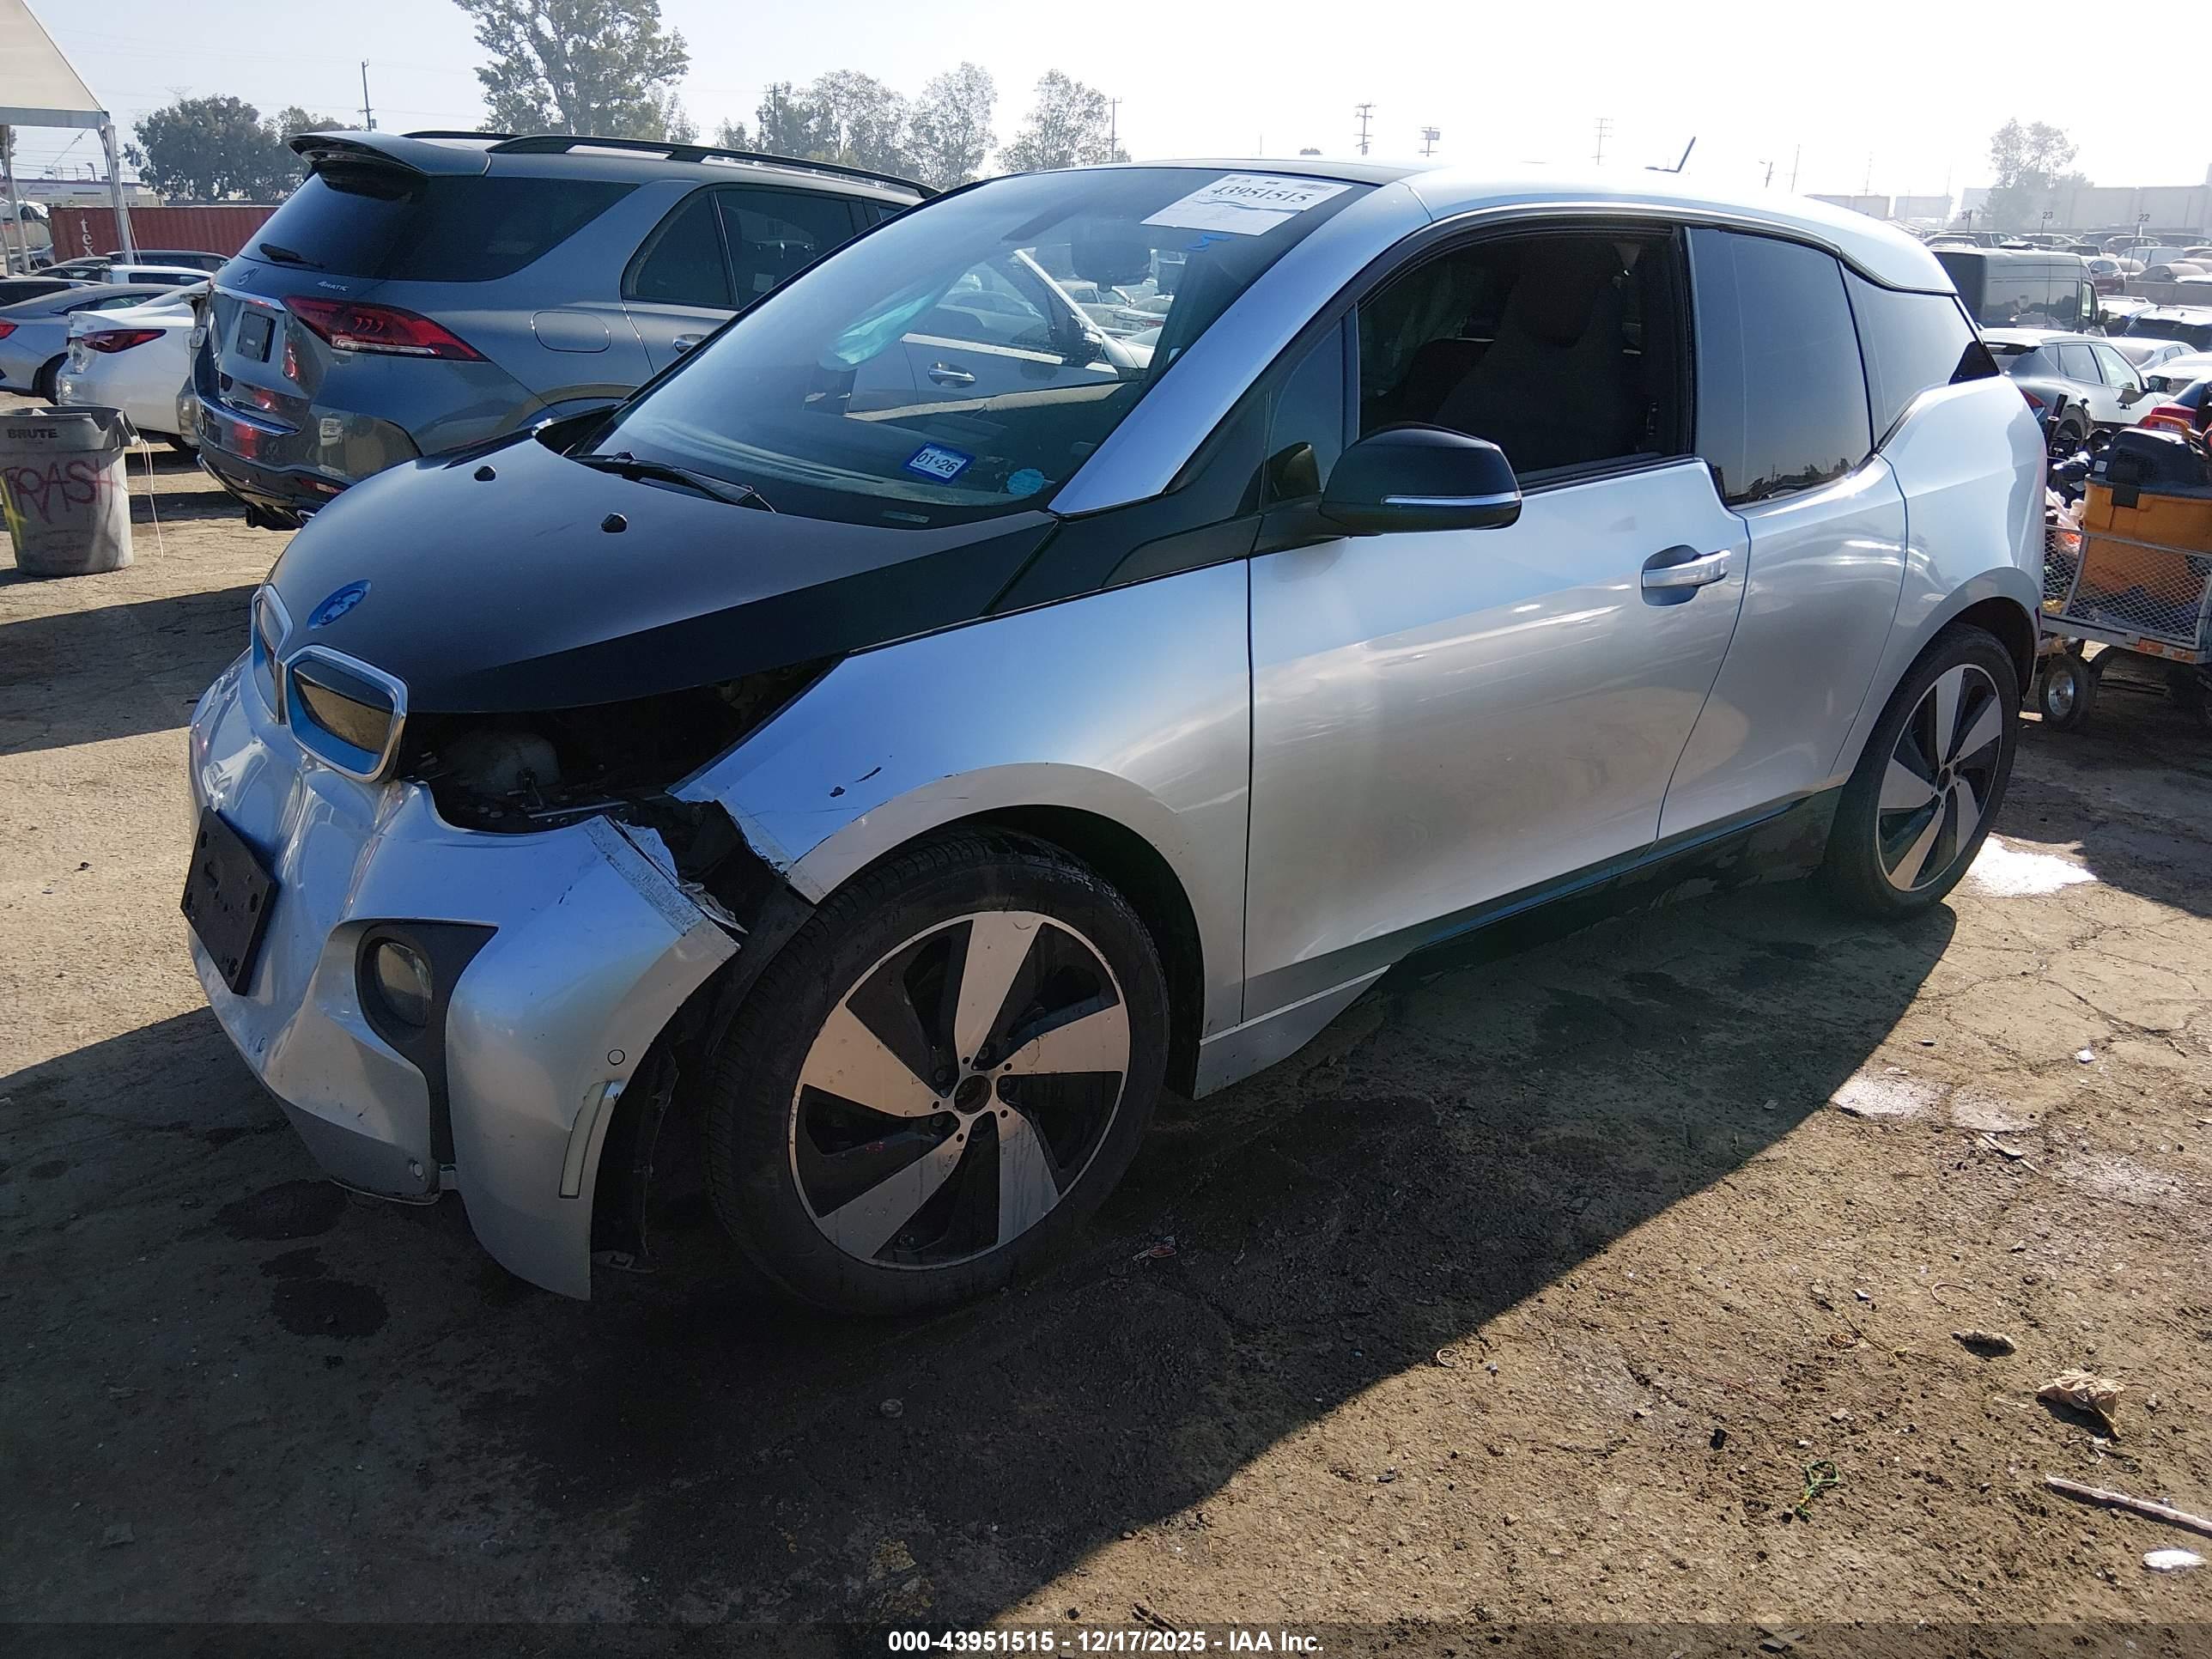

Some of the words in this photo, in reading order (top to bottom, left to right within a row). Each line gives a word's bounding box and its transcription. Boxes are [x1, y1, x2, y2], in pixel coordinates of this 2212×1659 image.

[1210, 185, 1315, 204] 43951515
[2042, 211, 2053, 220] 23
[80, 218, 95, 257] tex
[317, 281, 349, 291] 4MATIC
[7, 428, 60, 439] BRUTE
[916, 453, 936, 465] 01
[937, 459, 958, 472] 26
[2, 458, 118, 525] TRASH
